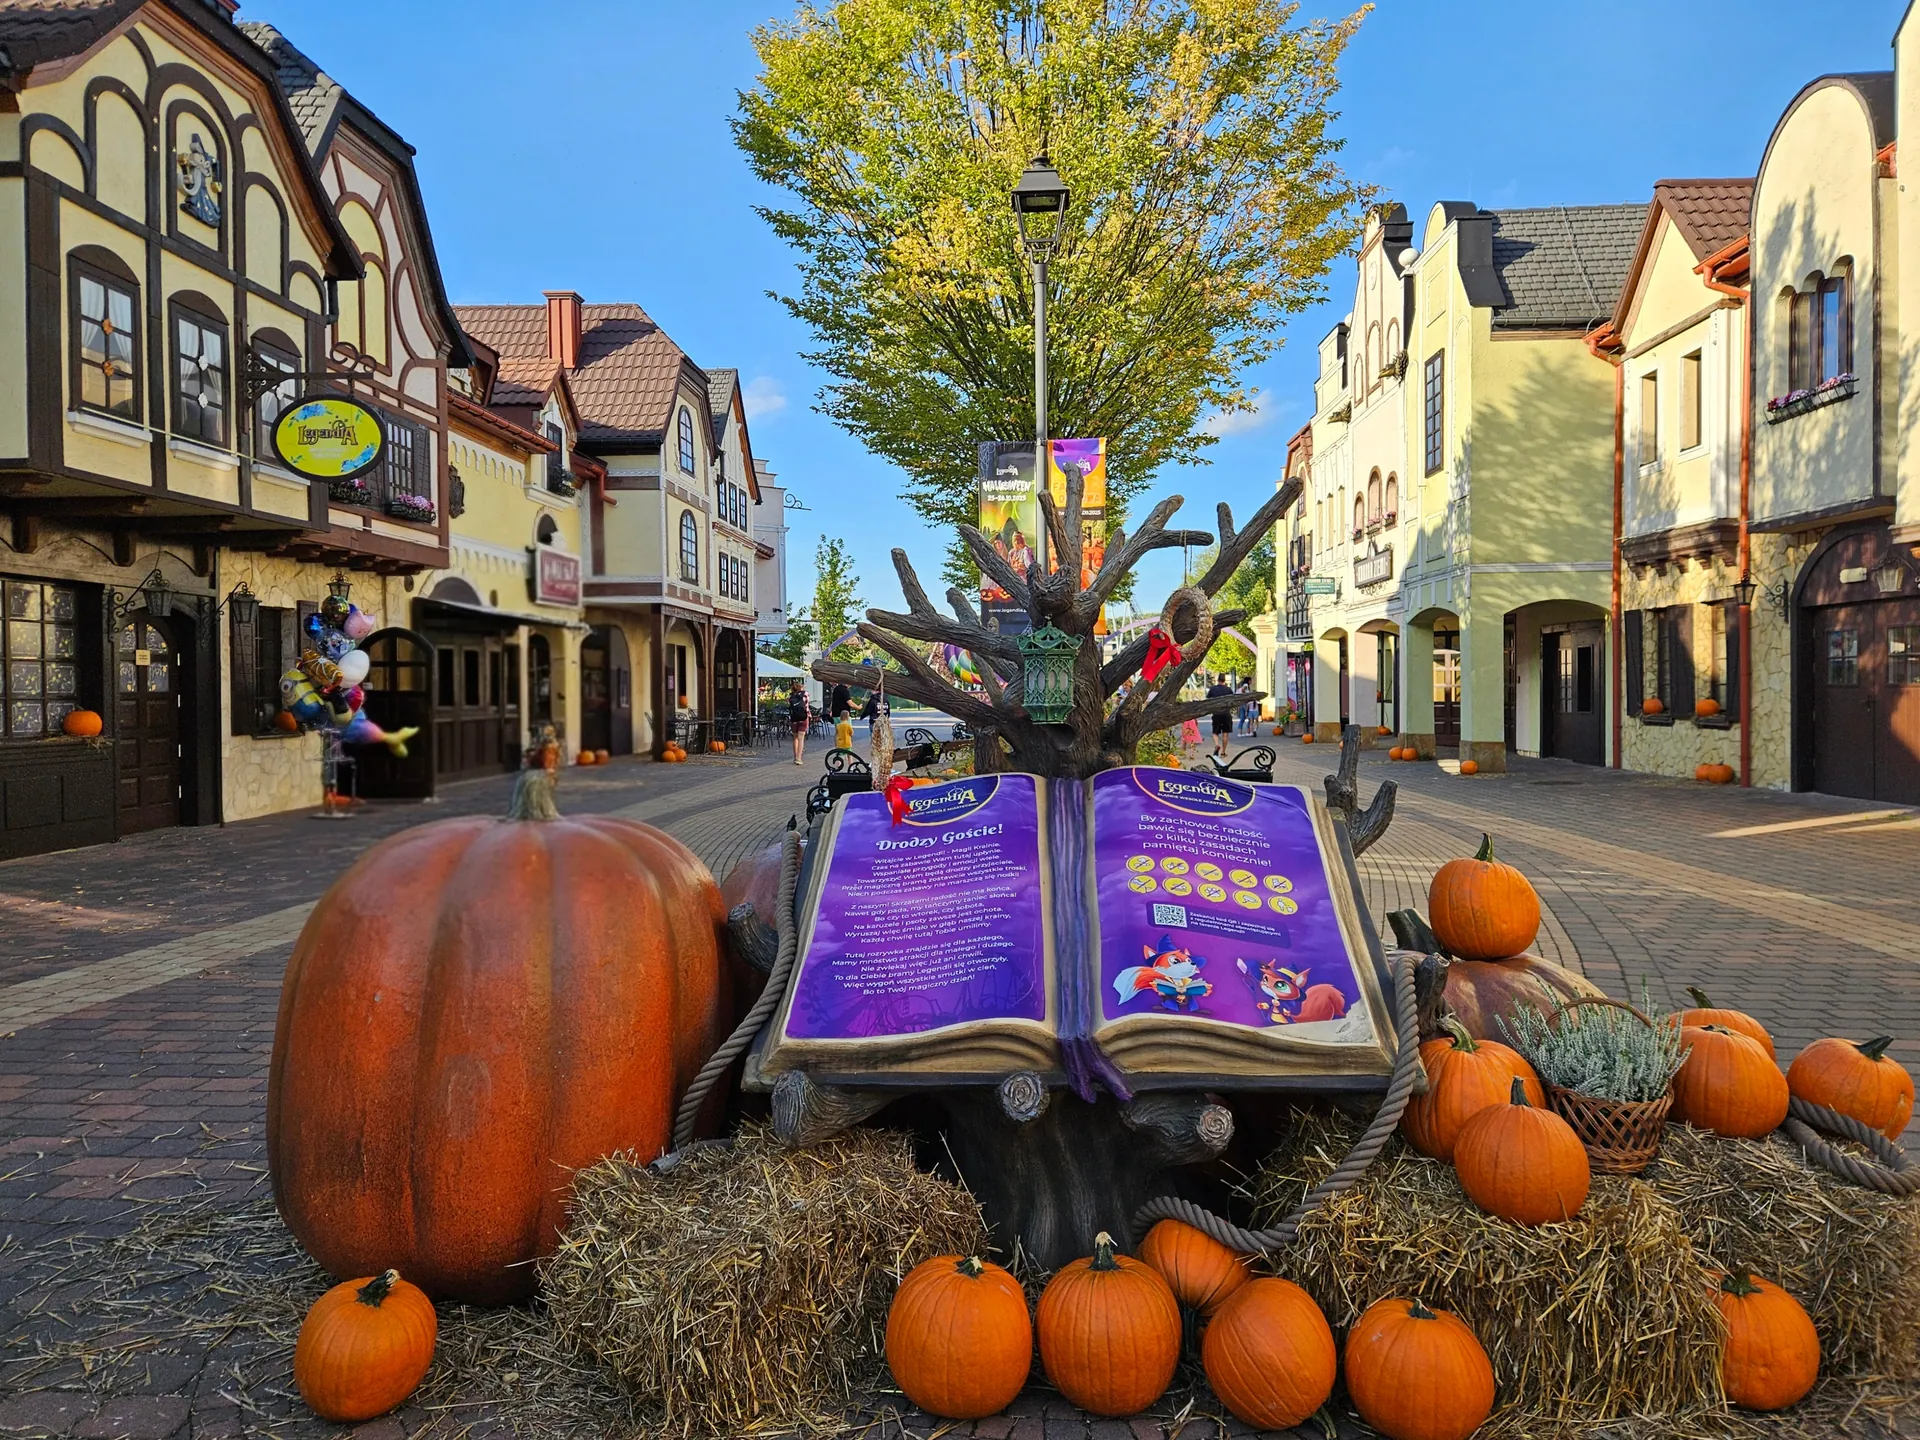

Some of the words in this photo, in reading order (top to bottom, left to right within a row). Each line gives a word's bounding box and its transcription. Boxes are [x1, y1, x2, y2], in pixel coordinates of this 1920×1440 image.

[1160, 817, 1220, 831] zachować
[876, 837, 937, 850] Drodzy
[943, 824, 1003, 844] Goście!
[1139, 824, 1174, 832] bawić
[1178, 828, 1194, 836] się
[1198, 830, 1270, 849] bezpiecznie
[1167, 834, 1195, 844] kilku
[1199, 840, 1256, 855] zasadach
[914, 850, 945, 860] Legendii
[1143, 842, 1198, 854] pamiętaj
[1202, 848, 1272, 867] koniecznie!
[913, 863, 947, 873] przygody
[952, 858, 978, 866] emocji
[929, 873, 966, 882] zostawcie
[967, 867, 1003, 876] wszystkie
[948, 877, 983, 885] marszczą
[891, 897, 930, 907] Skrzatami
[930, 893, 957, 902] radość
[925, 898, 963, 908] tańczymy
[958, 915, 983, 924] naszej
[899, 952, 929, 961] atrakcji
[945, 945, 976, 954] małego
[906, 944, 938, 953] znajdzie
[876, 963, 907, 971] zwlekaj
[917, 964, 952, 974] Legendii
[897, 975, 936, 984] wszystkie
[938, 968, 966, 979] smutki
[909, 980, 949, 991] magiczny
[950, 975, 975, 983] dzień!
